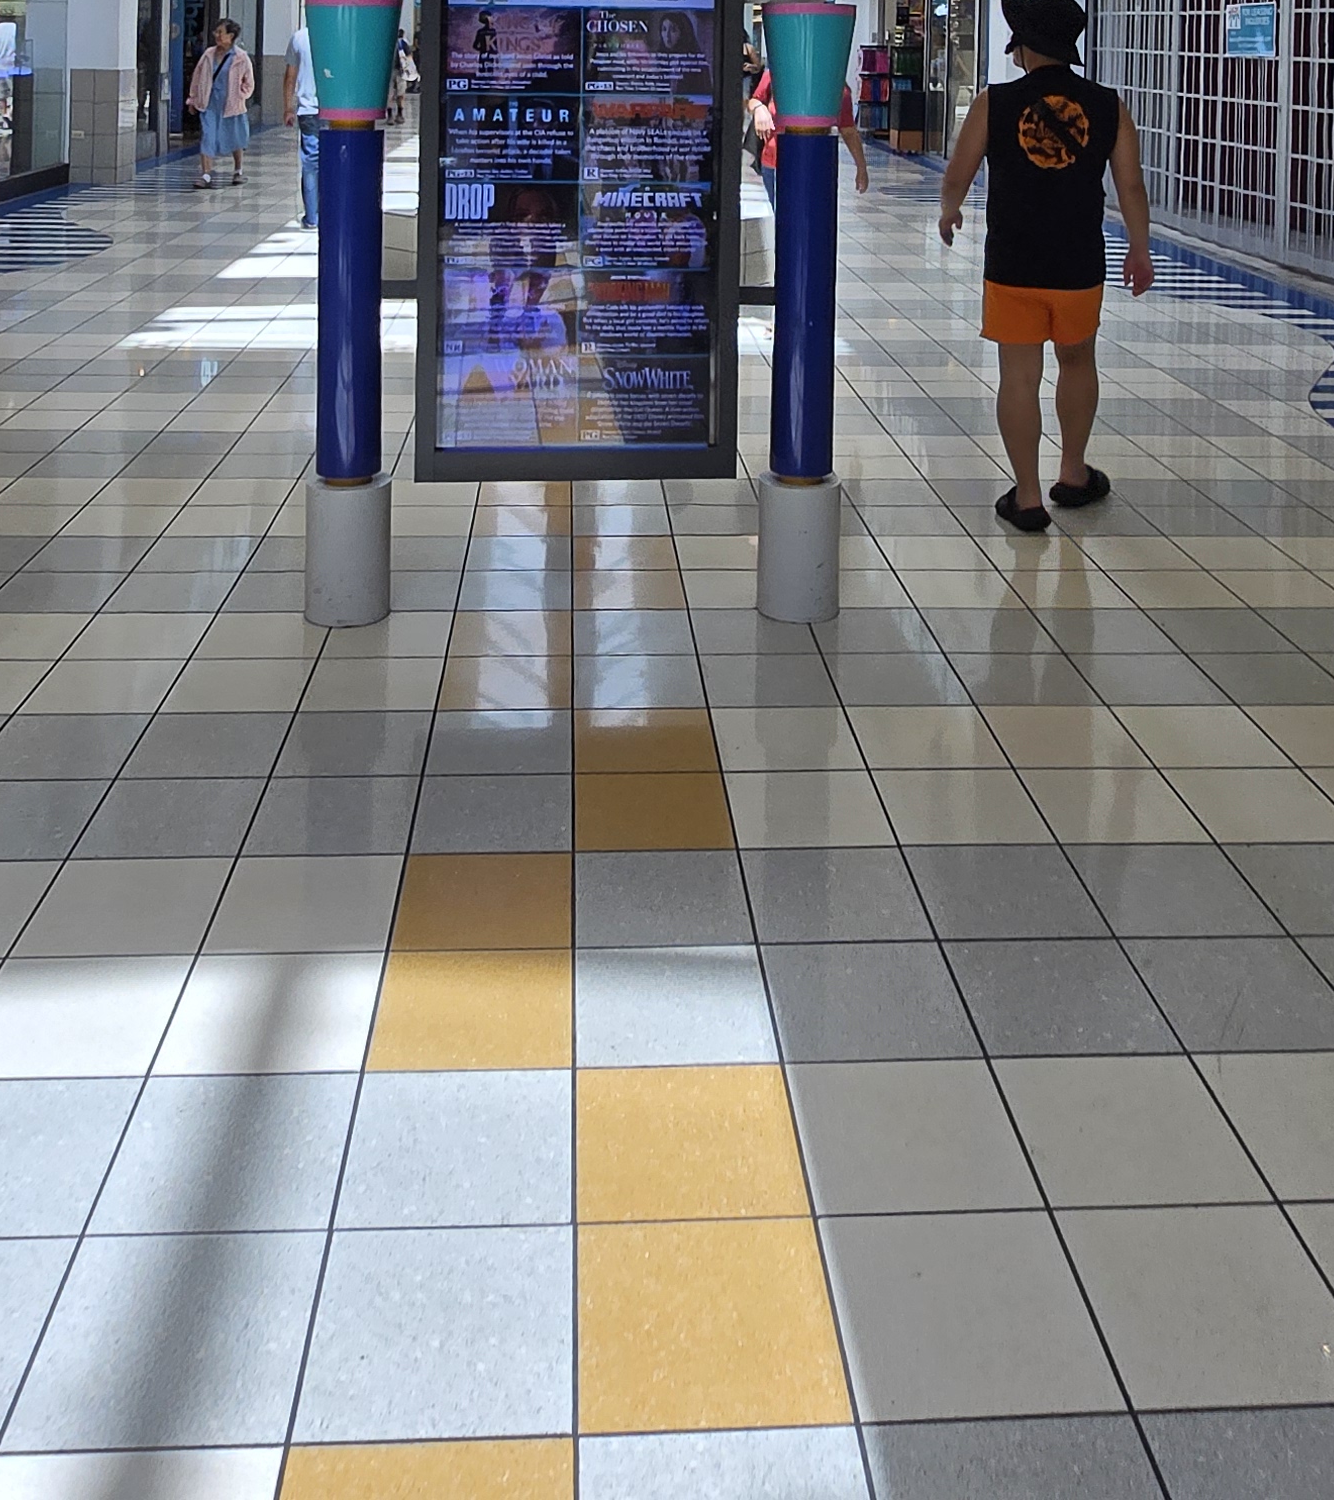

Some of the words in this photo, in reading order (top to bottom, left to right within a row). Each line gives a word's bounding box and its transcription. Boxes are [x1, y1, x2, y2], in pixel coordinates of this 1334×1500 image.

[599, 11, 616, 19] The
[586, 20, 648, 33] CHOSEN
[485, 35, 542, 52] KINGS
[448, 80, 466, 89] PG
[453, 107, 570, 122] AMATEUR
[587, 169, 596, 177] R
[445, 184, 495, 219] DROP
[593, 192, 702, 207] MINECRAFT
